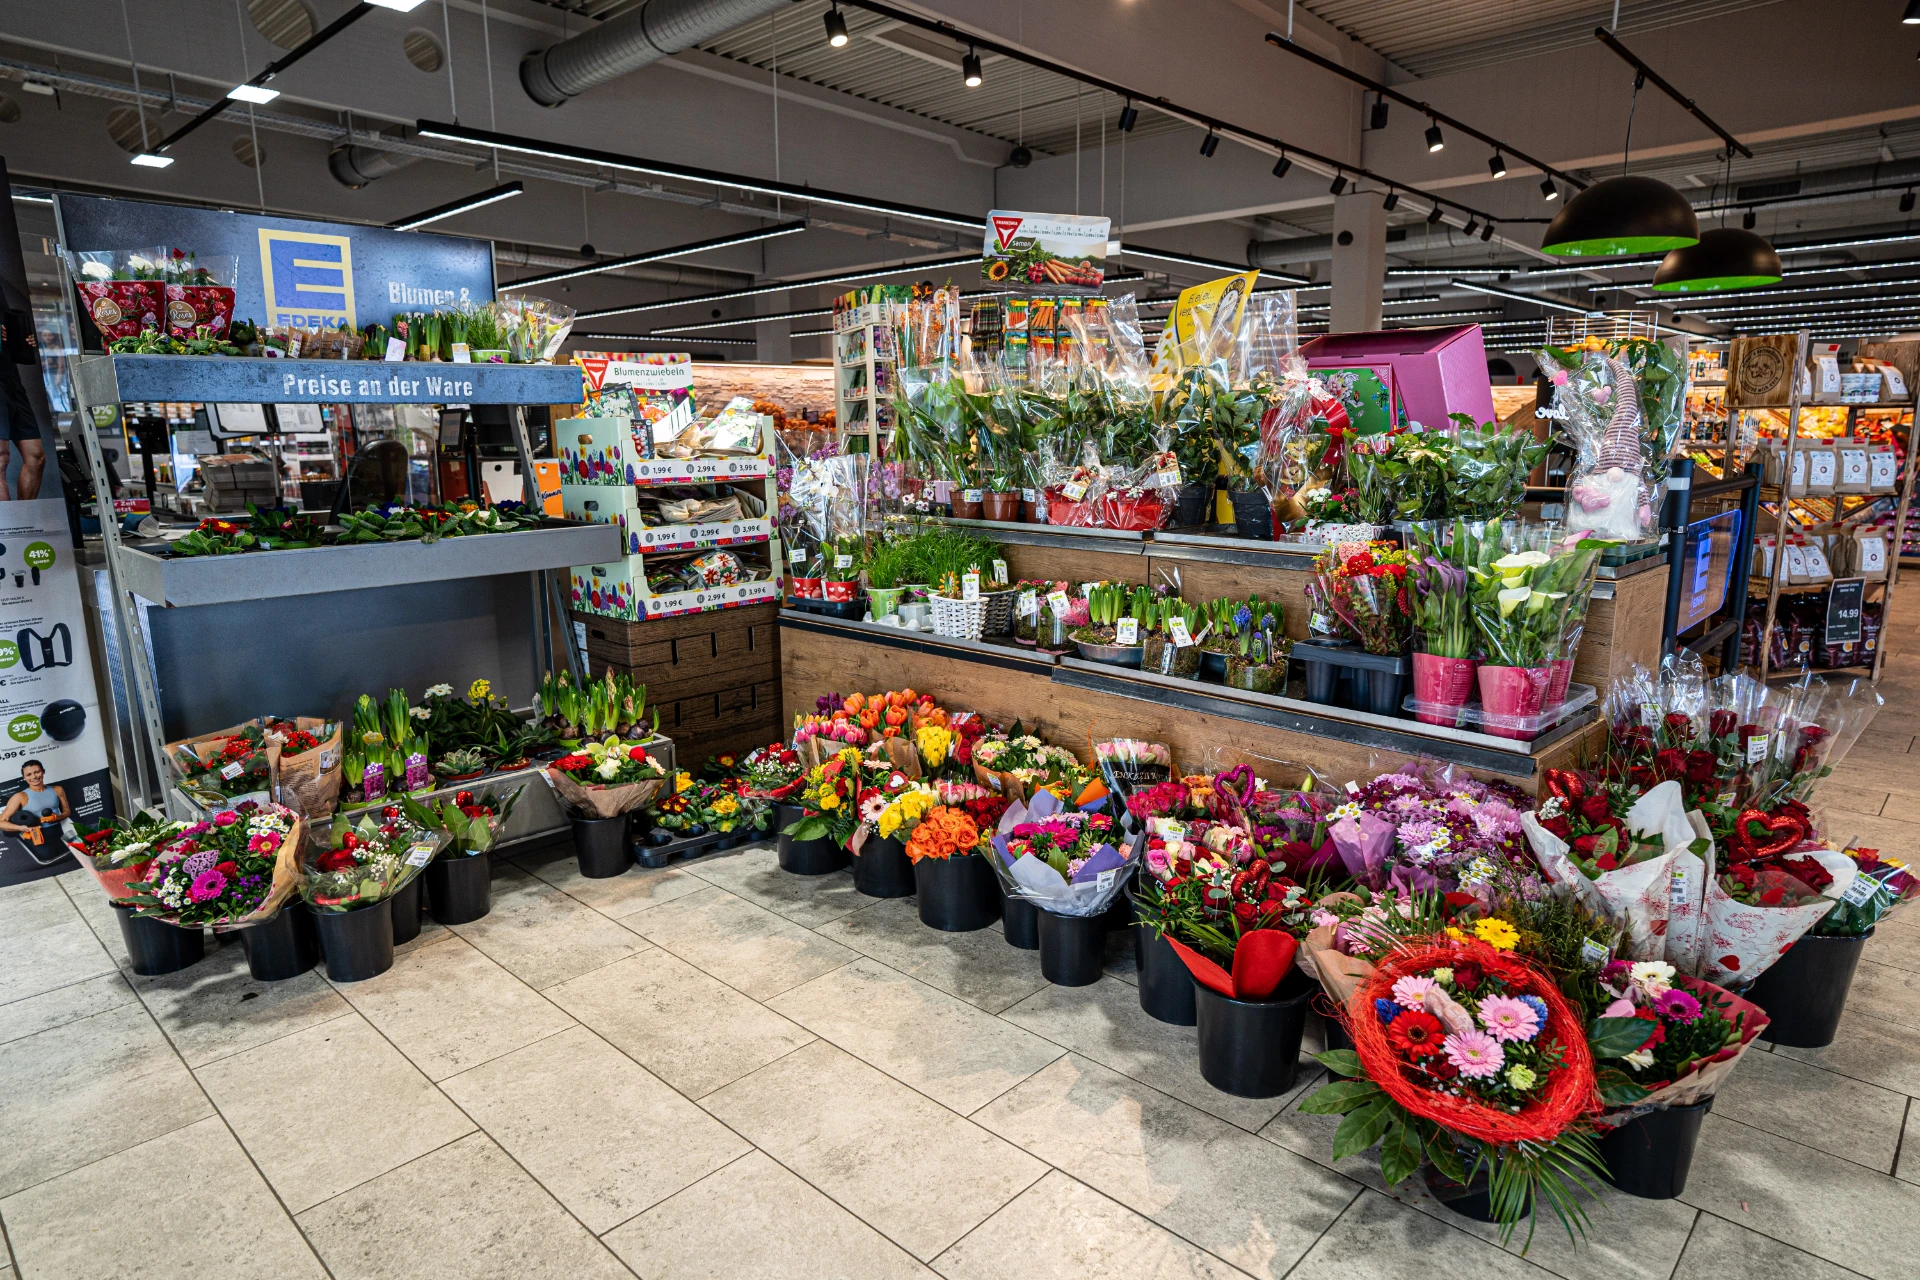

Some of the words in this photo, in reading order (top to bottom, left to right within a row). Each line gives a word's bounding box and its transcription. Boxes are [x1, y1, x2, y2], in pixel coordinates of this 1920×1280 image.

[388, 281, 454, 305] Blumen
[96, 307, 117, 319] Roses
[170, 310, 192, 320] Roses
[276, 313, 349, 329] EDEKA
[614, 367, 685, 377] Blumenzwiebeln
[282, 374, 352, 396] Preise
[358, 378, 382, 396] an
[388, 376, 420, 396] der
[425, 376, 473, 397] Ware
[697, 465, 711, 473] 2,99
[739, 464, 753, 472] 3,99
[657, 533, 670, 541] 1,99
[671, 532, 676, 540] €
[701, 529, 715, 537] 2,99
[715, 528, 720, 536] €
[742, 525, 756, 533] 3,99
[756, 524, 761, 532] €
[664, 600, 677, 608] 1,99
[678, 599, 683, 607] €
[721, 592, 726, 600] €
[1838, 609, 1859, 619] 14.99
[17, 730, 37, 738] sparen
[0, 751, 17, 761] ,99
